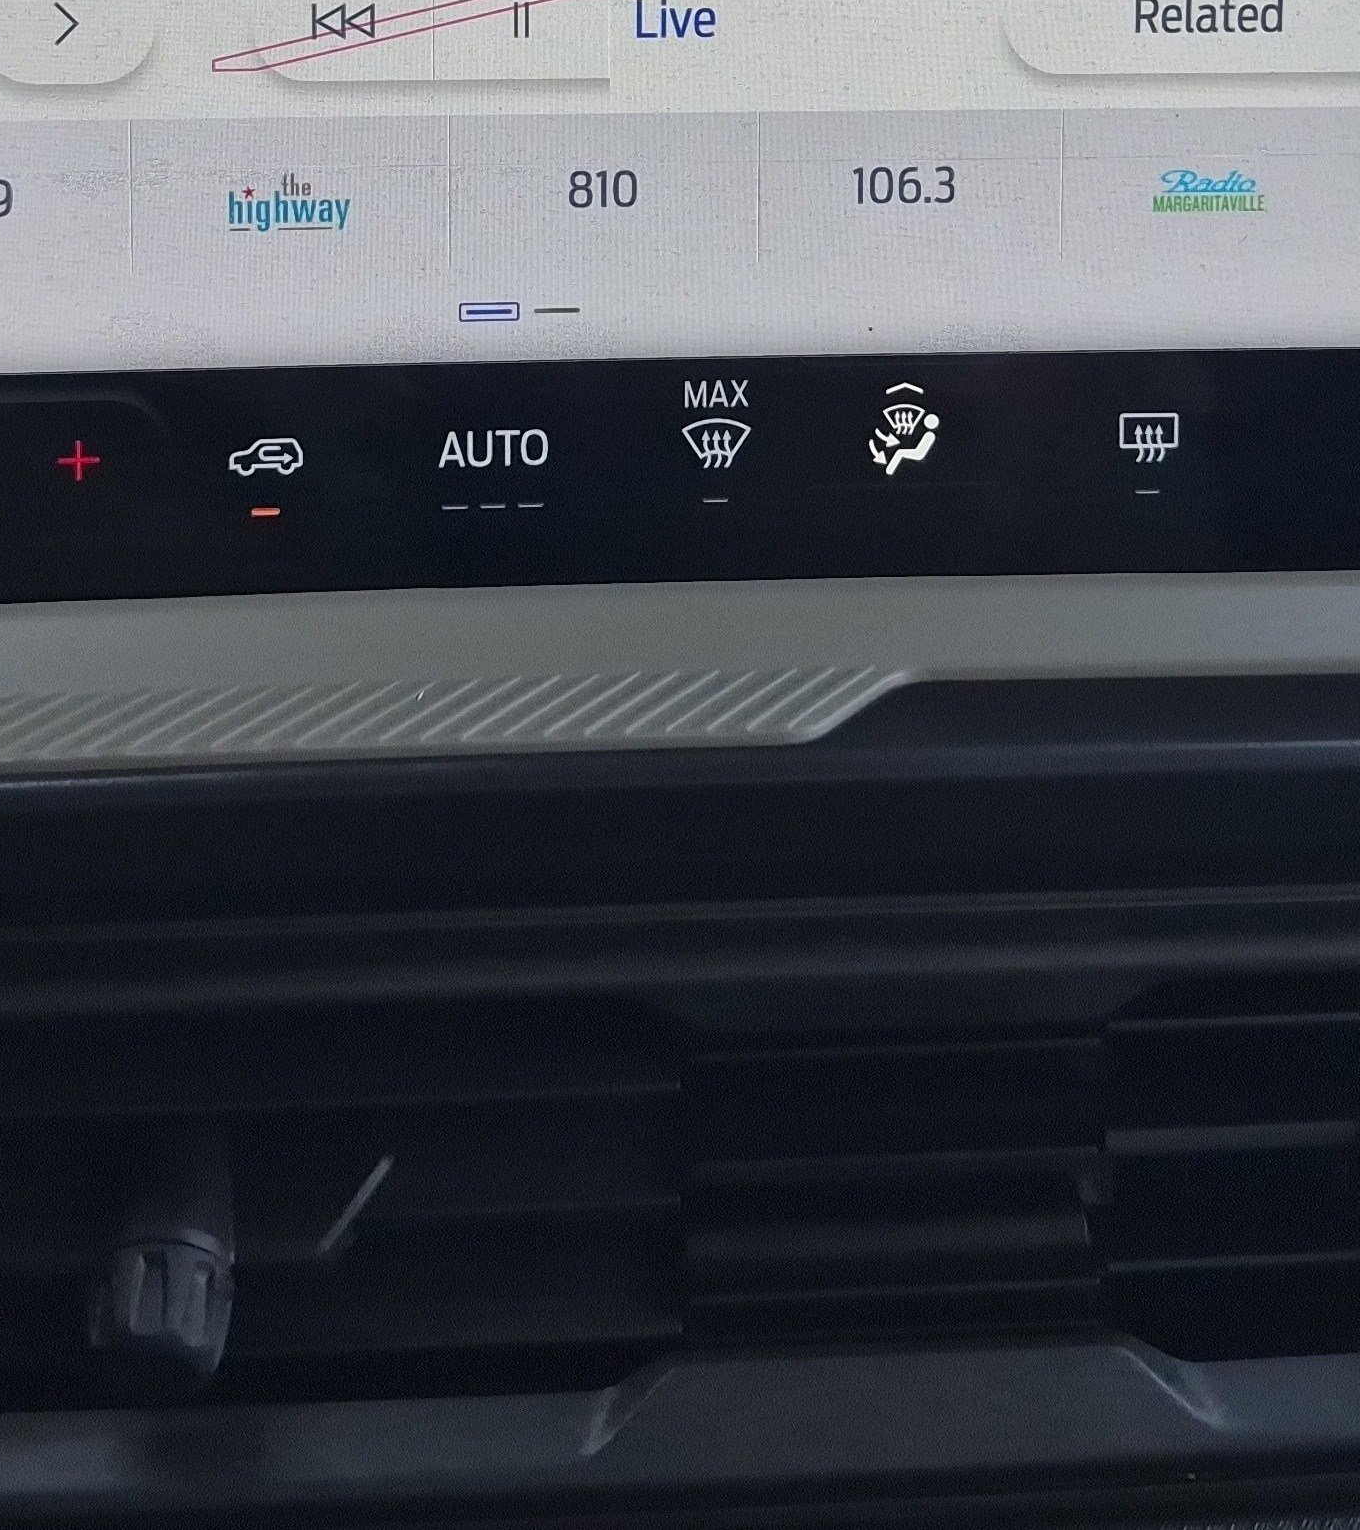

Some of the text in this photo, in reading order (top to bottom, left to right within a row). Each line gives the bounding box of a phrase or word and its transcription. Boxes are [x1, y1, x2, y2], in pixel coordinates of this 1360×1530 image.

[281, 172, 312, 197] the
[568, 170, 639, 209] 810
[852, 166, 957, 206] 106.3
[1160, 169, 1257, 193] Radio
[228, 190, 351, 233] highway
[1151, 194, 1267, 213] MARGARITAVILLE
[683, 381, 749, 409] MAX
[439, 428, 549, 468] AUTO
